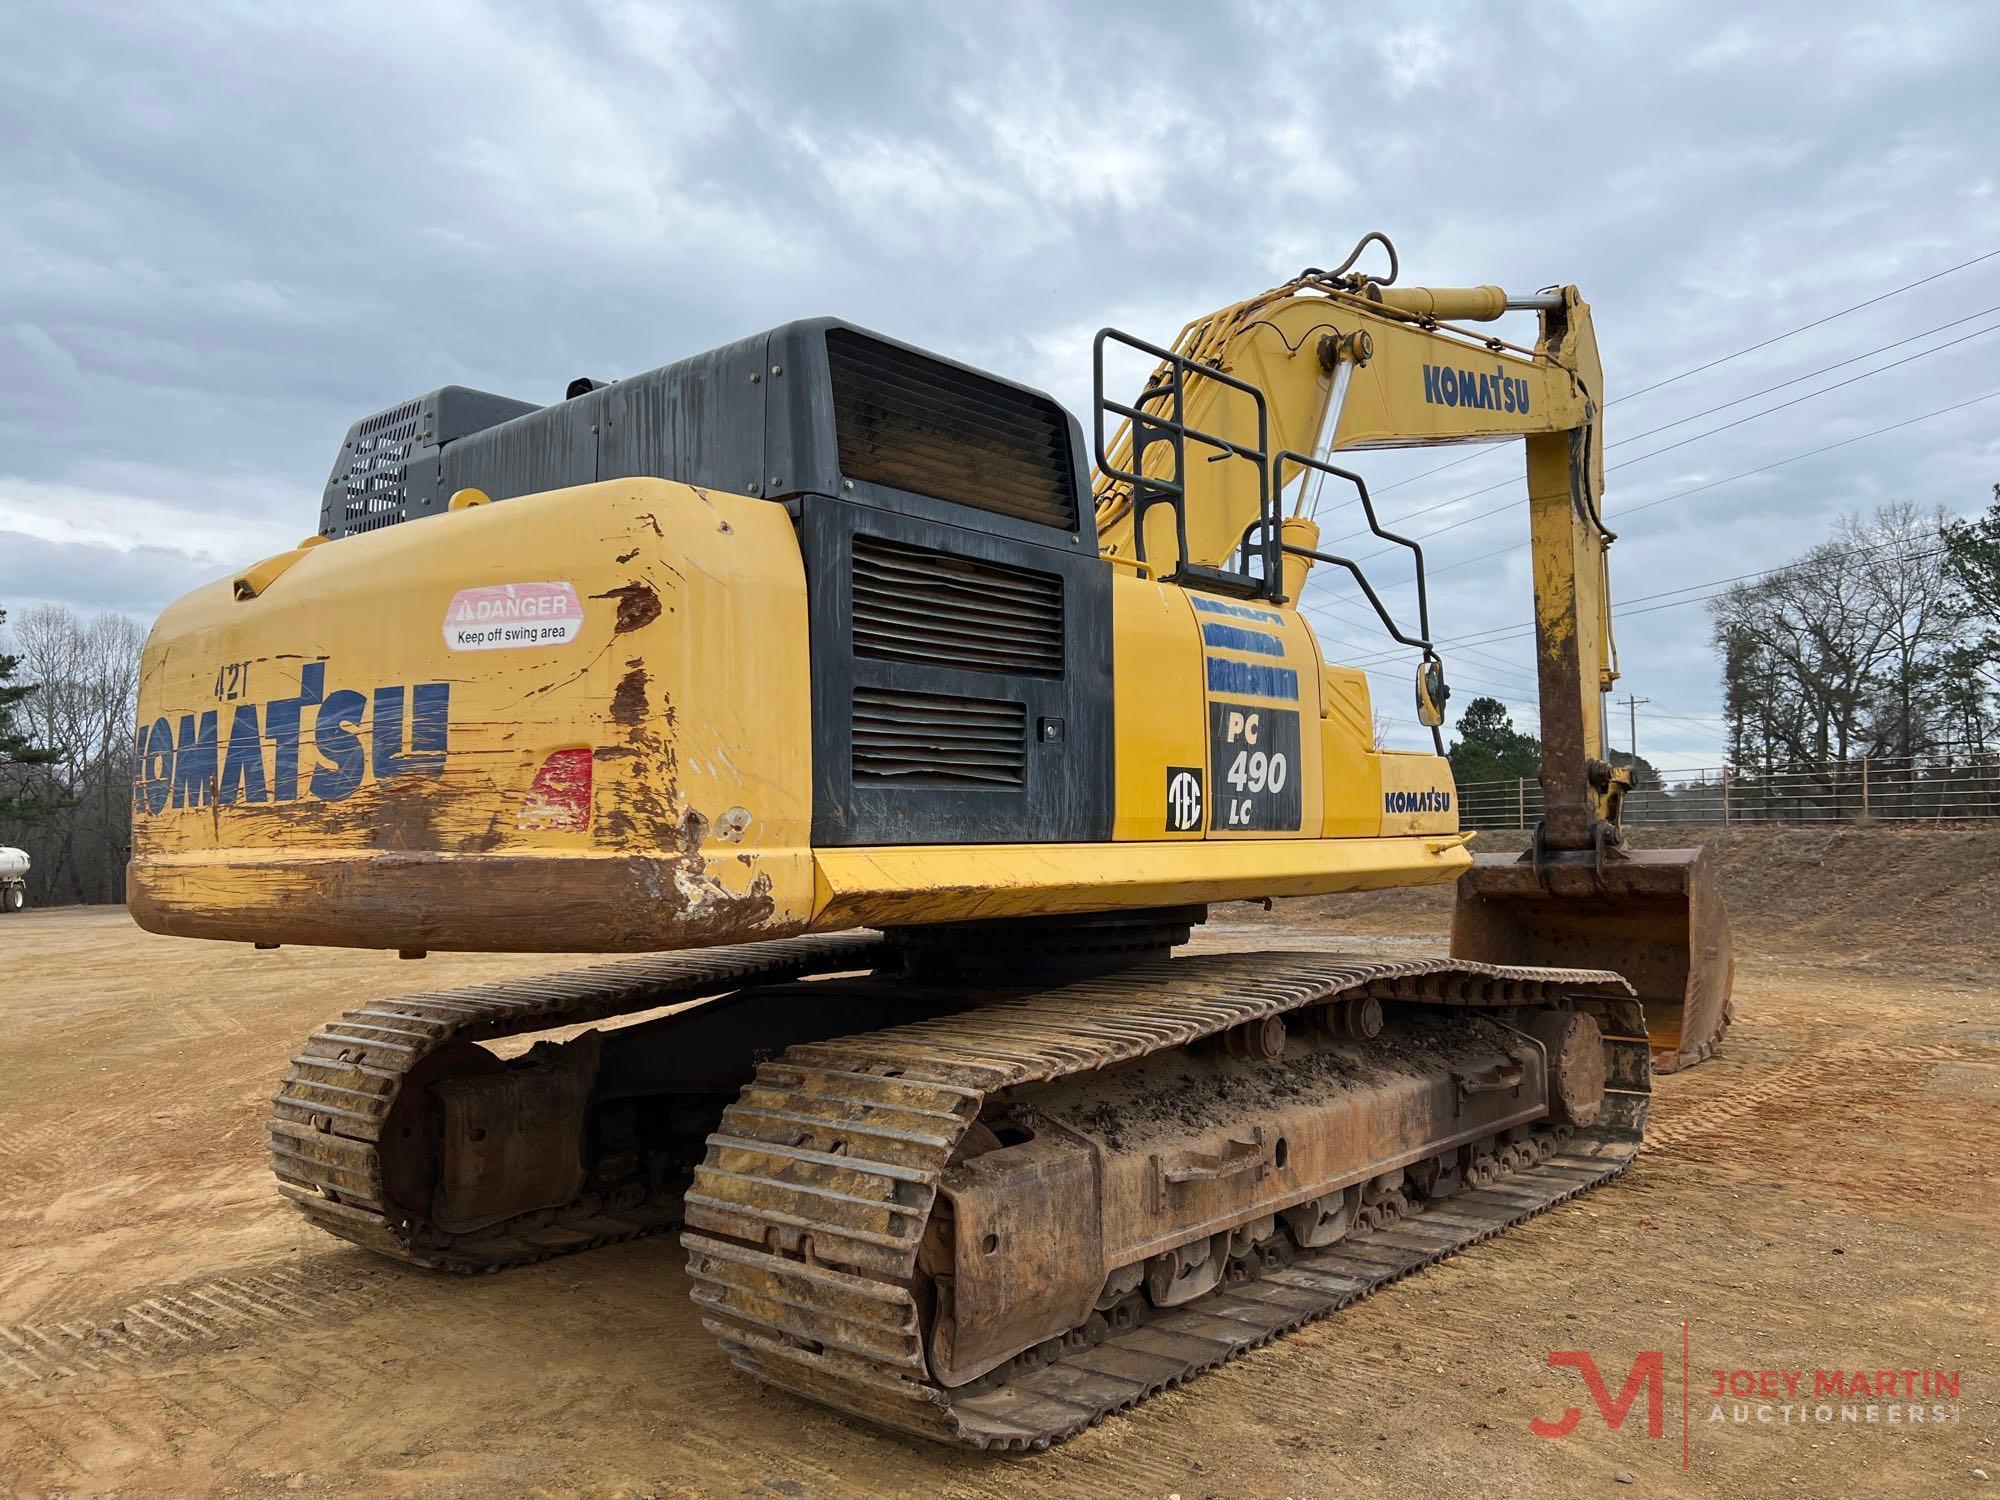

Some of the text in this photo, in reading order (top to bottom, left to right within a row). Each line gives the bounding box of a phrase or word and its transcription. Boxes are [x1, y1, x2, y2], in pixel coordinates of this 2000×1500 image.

[1423, 364, 1529, 414] KOMATSU
[476, 596, 568, 619] DANGER
[458, 626, 565, 645] Keep off swing area
[1227, 712, 1259, 745] PC
[1227, 750, 1287, 793] 490
[1228, 799, 1252, 824] LC
[1385, 786, 1450, 813] KOMATSU
